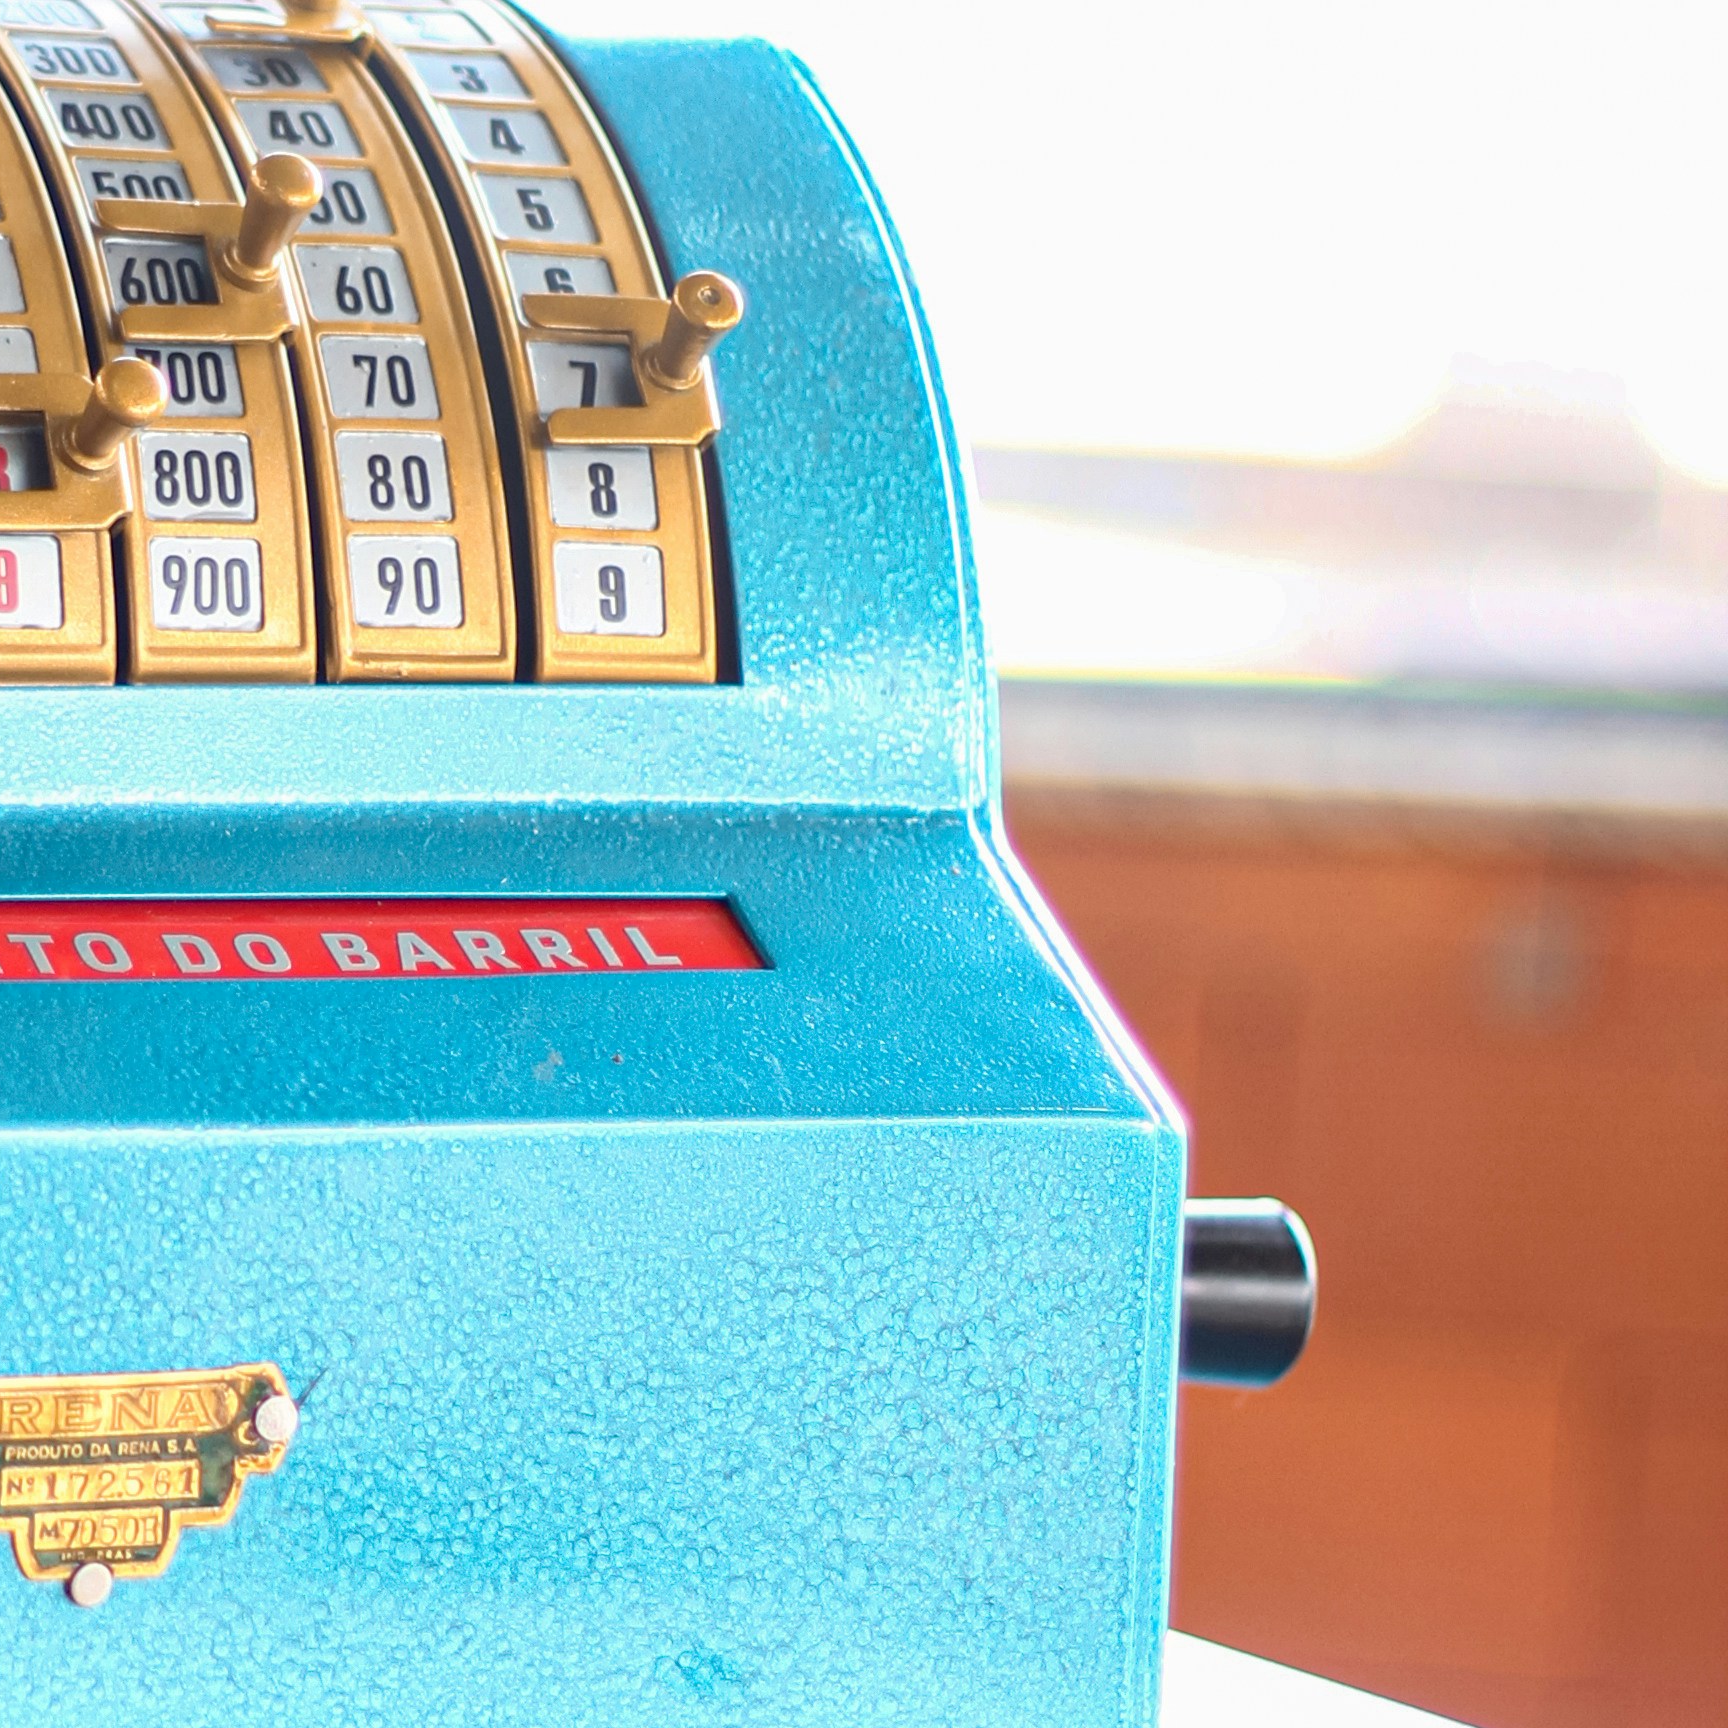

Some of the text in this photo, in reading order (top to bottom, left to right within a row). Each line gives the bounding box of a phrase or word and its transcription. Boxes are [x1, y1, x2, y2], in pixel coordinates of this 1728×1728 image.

[25, 43, 119, 77] 300
[242, 56, 303, 89] 30
[451, 64, 488, 94] 3
[60, 101, 156, 143] 400
[270, 108, 335, 149] 40
[488, 117, 526, 156] 4
[515, 187, 555, 232] 5
[119, 256, 204, 306] 600
[334, 264, 395, 316] 60
[351, 353, 416, 409] 70
[566, 359, 599, 405] 7
[153, 448, 236, 507] 800
[367, 453, 432, 511] 80
[587, 461, 618, 517] 8
[163, 554, 250, 614] 900
[377, 556, 441, 614] 90
[598, 564, 627, 620] 9
[160, 931, 292, 974] DO
[319, 925, 684, 973] BARRIL
[4, 1443, 84, 1461] PRODUTO
[90, 1442, 111, 1458] DA
[117, 1440, 161, 1456] RENA
